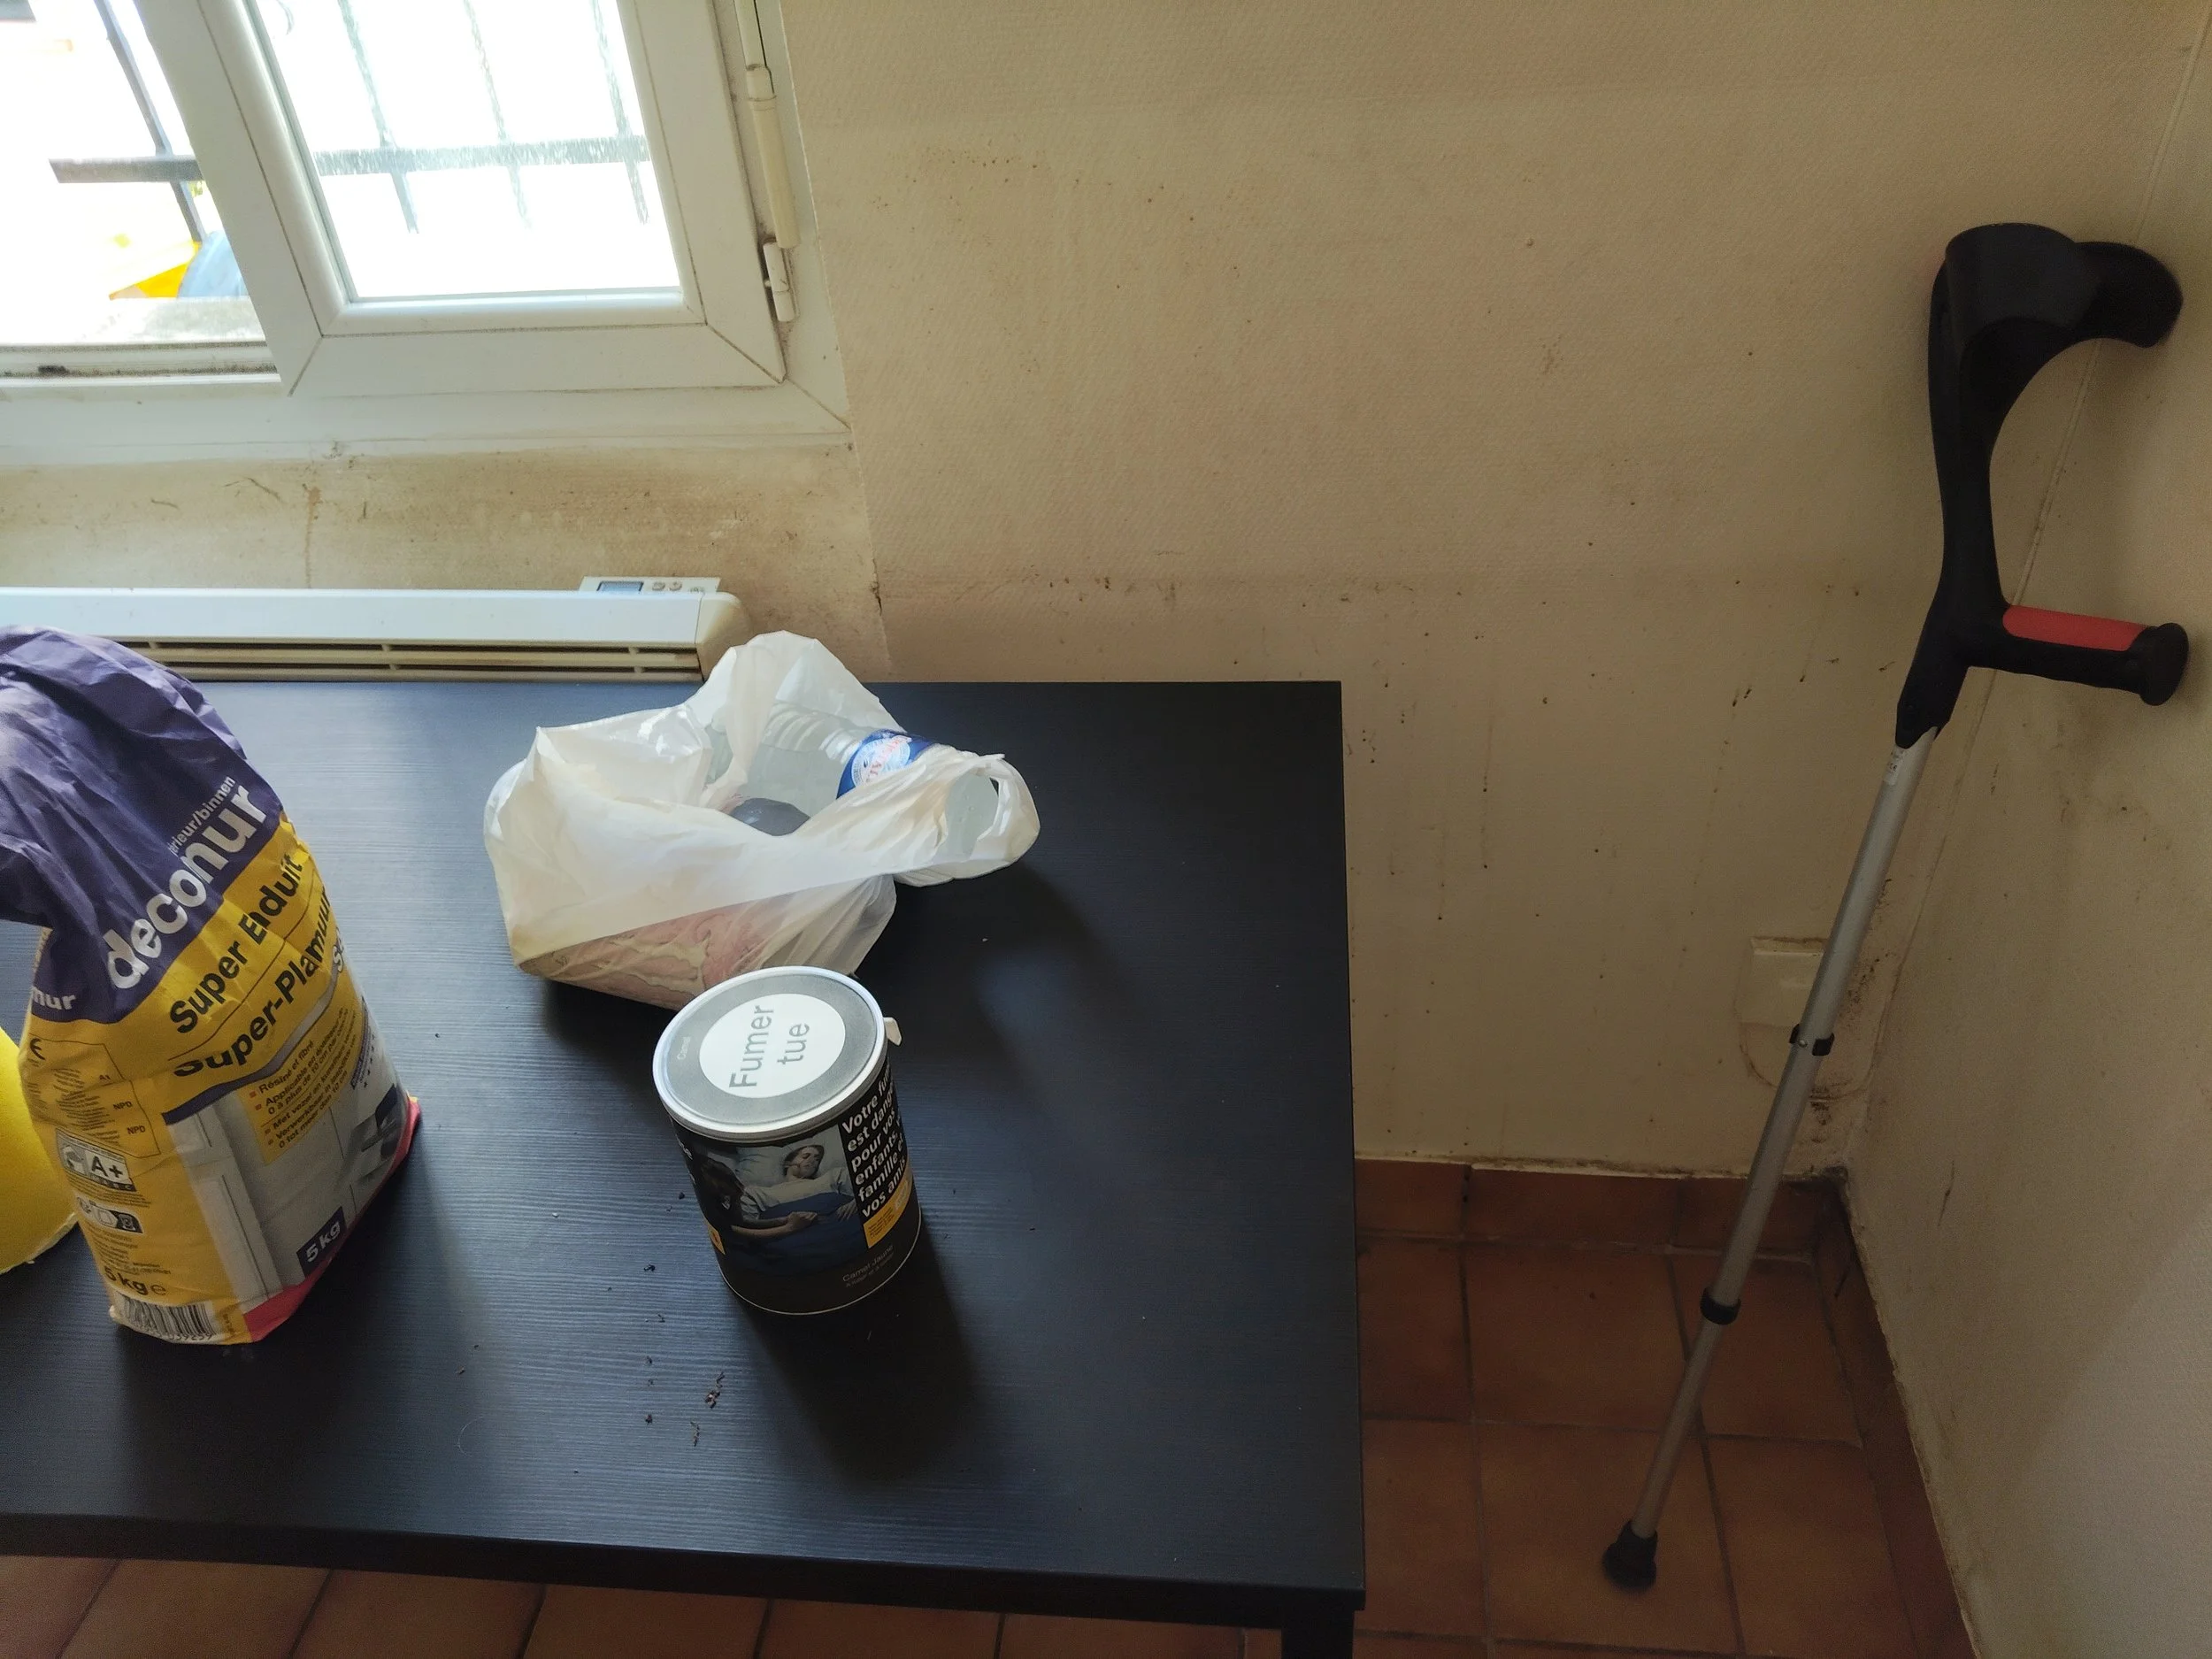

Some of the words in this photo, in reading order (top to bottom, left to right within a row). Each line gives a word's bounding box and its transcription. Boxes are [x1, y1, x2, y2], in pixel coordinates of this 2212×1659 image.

[169, 940, 248, 1034] Super
[238, 852, 303, 946] Enduit
[728, 1004, 775, 1088] Fumer
[776, 1022, 811, 1065] tue
[112, 1100, 133, 1111] NPD
[841, 1094, 879, 1134] Votre
[127, 1124, 147, 1135] NPD
[847, 1128, 871, 1153] est
[850, 1133, 883, 1173] pour
[882, 1107, 895, 1135] vos
[91, 1155, 124, 1179] A+
[857, 1152, 899, 1203] famille
[861, 1191, 887, 1218] vos
[887, 1156, 906, 1194] amis
[305, 1242, 319, 1263] 5
[319, 1221, 342, 1250] kg
[104, 1265, 117, 1281] 5
[117, 1271, 150, 1296] kg
